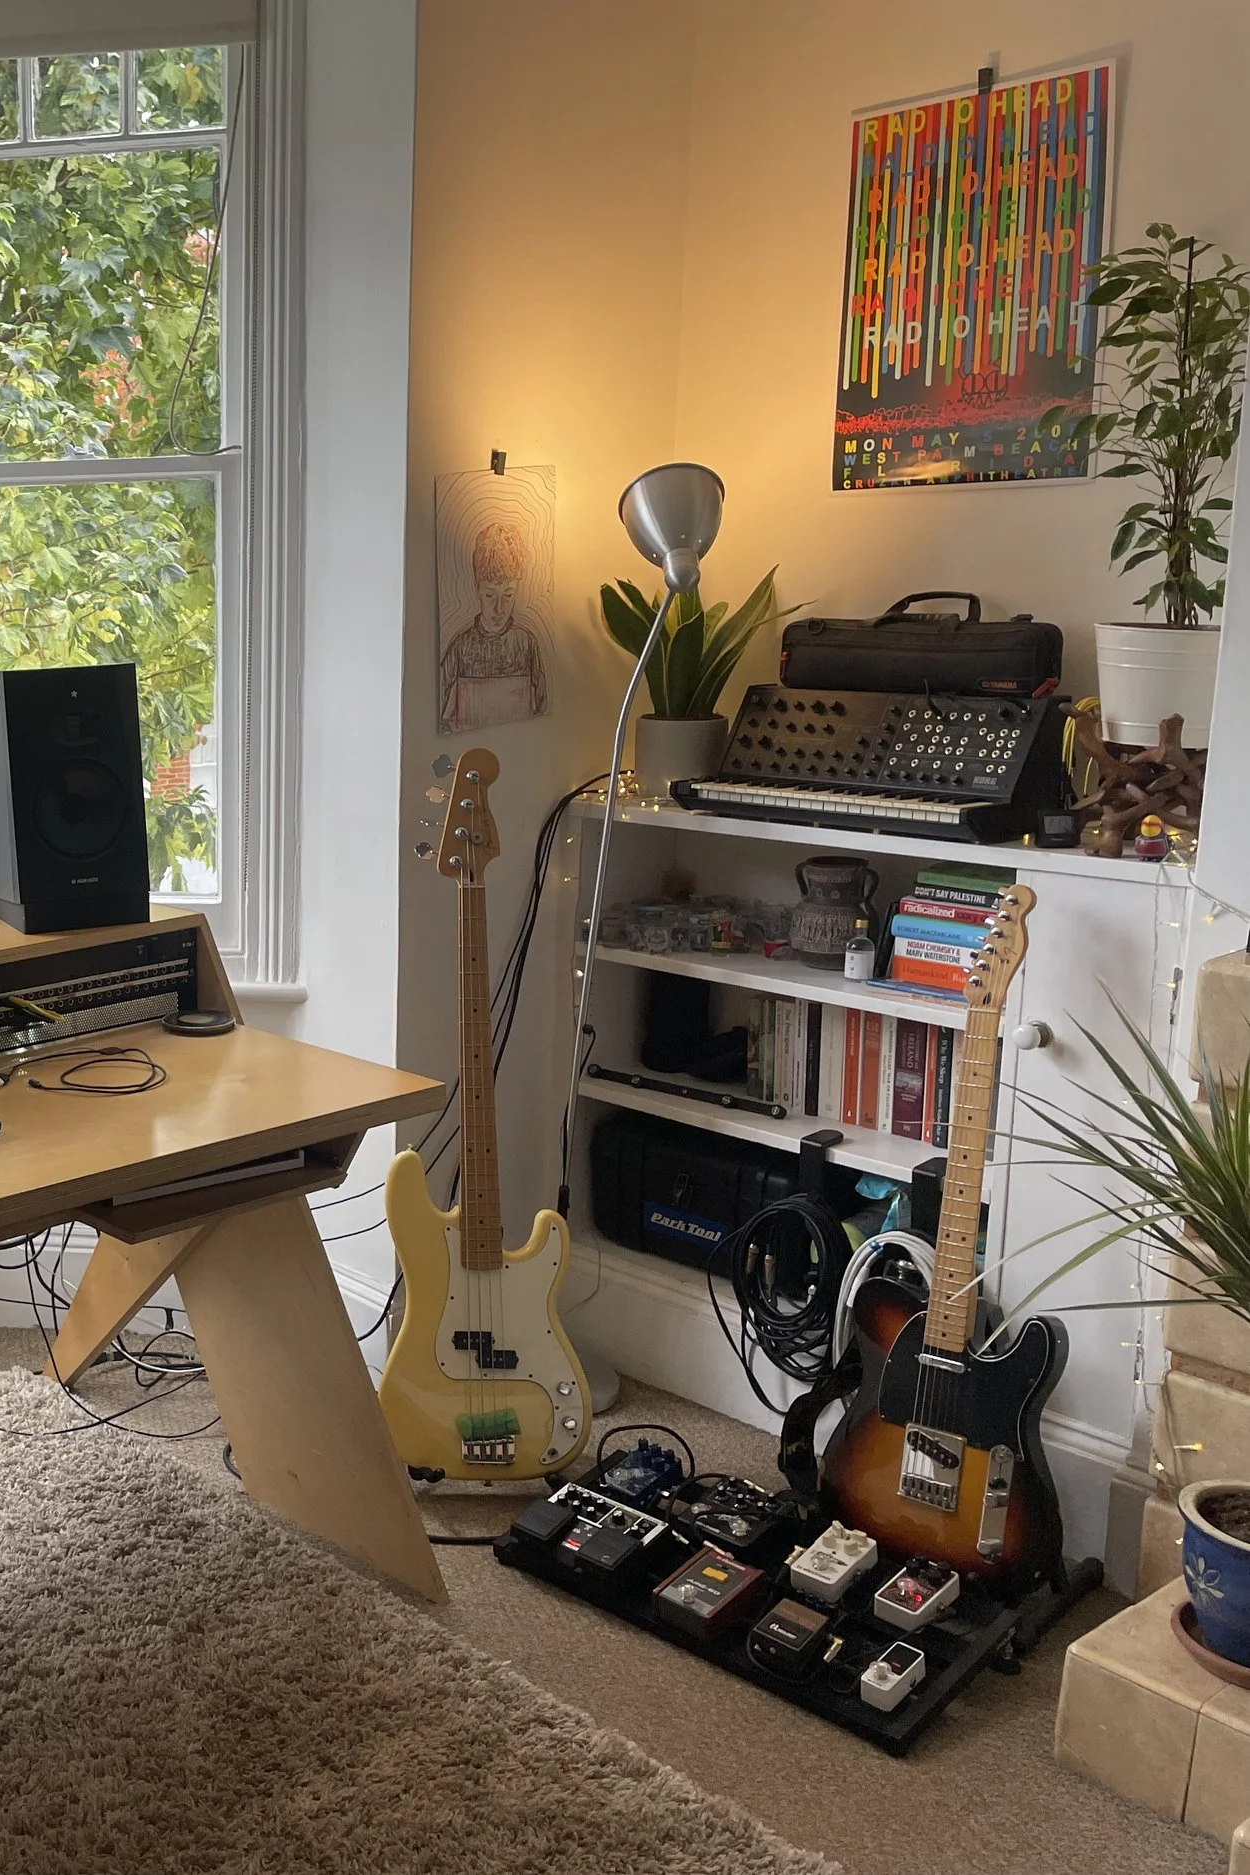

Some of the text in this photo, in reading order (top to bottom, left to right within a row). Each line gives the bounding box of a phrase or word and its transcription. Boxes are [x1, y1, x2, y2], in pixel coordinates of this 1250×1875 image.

[844, 437, 893, 454] MON
[911, 432, 960, 448] MAY
[843, 438, 1078, 466] WEST PALM BEACH
[935, 889, 949, 900] SAY
[950, 891, 987, 905] PALESTINE
[903, 903, 956, 919] radicalized
[907, 941, 925, 952] NOAM
[925, 943, 956, 956] CHOMSKY
[924, 951, 961, 964] WATERSTONE
[937, 1066, 947, 1084] Sleep
